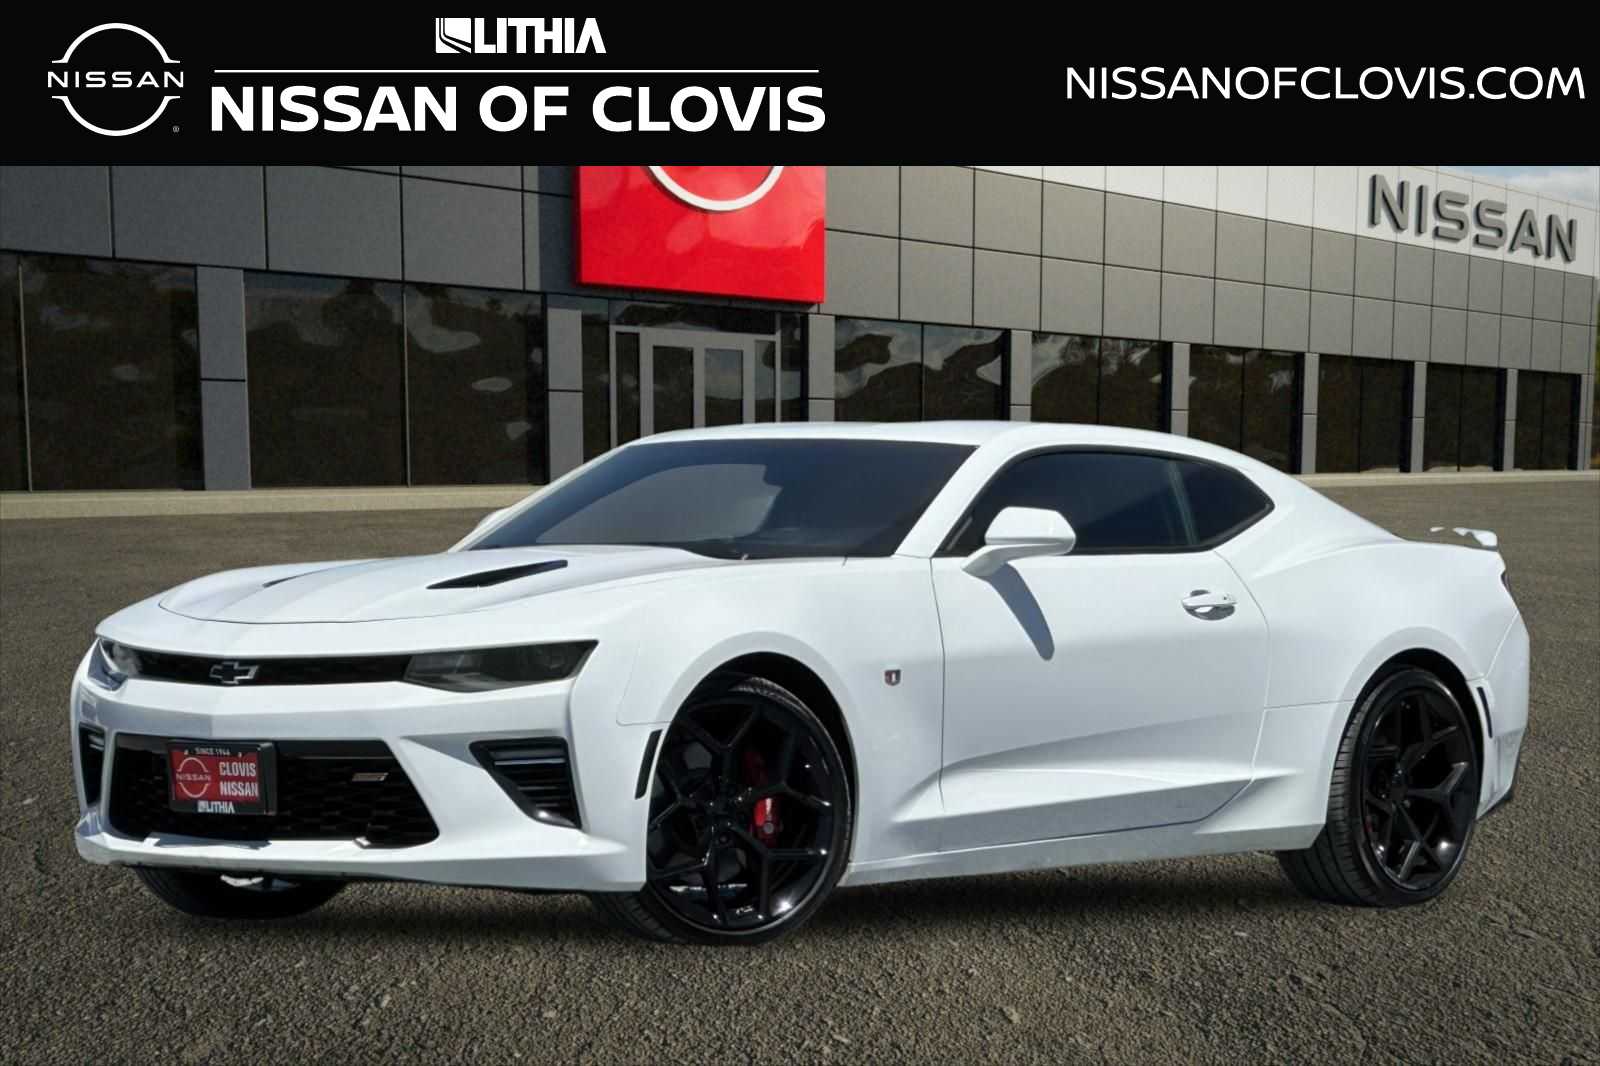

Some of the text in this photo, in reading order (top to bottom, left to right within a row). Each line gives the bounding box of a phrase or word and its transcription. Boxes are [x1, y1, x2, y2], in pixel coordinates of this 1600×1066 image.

[1368, 173, 1577, 263] NISSAN
[219, 762, 257, 776] CLOVIS
[176, 773, 211, 781] NISSAN
[219, 781, 259, 796] NISSAN
[206, 801, 235, 813] LITHIA
